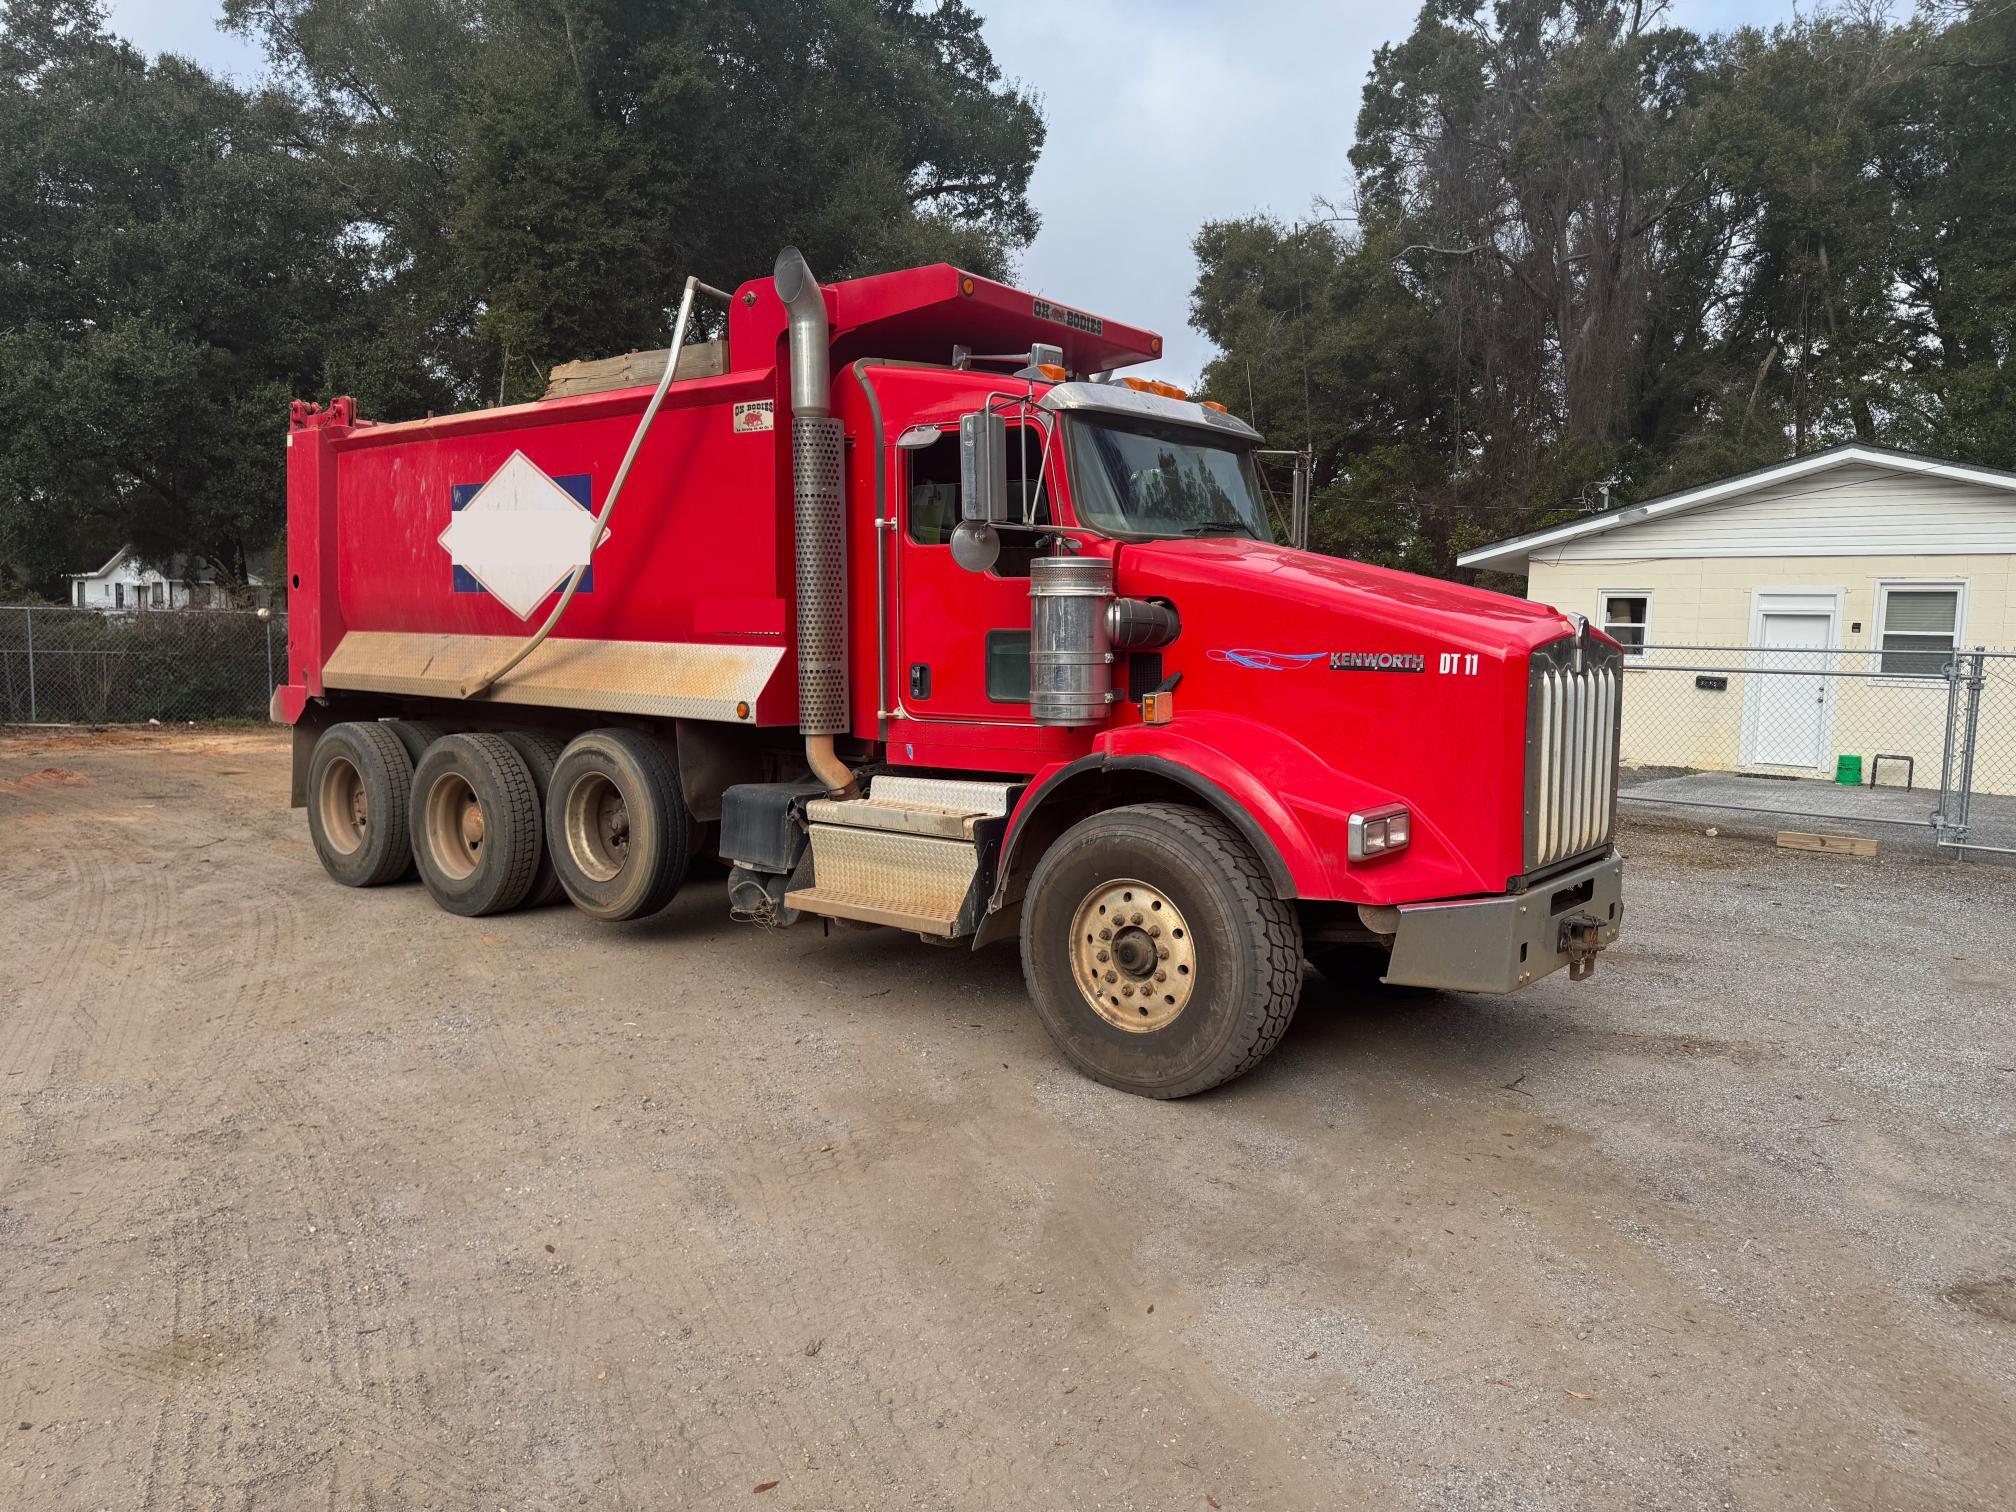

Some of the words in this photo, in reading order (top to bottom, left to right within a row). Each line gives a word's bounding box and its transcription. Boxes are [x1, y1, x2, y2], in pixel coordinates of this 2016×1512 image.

[1066, 310, 1102, 336] BODIES
[747, 402, 773, 412] BODIES
[1329, 652, 1425, 670] KENWORTH
[1439, 653, 1461, 675] DT
[1464, 654, 1479, 676] 11
